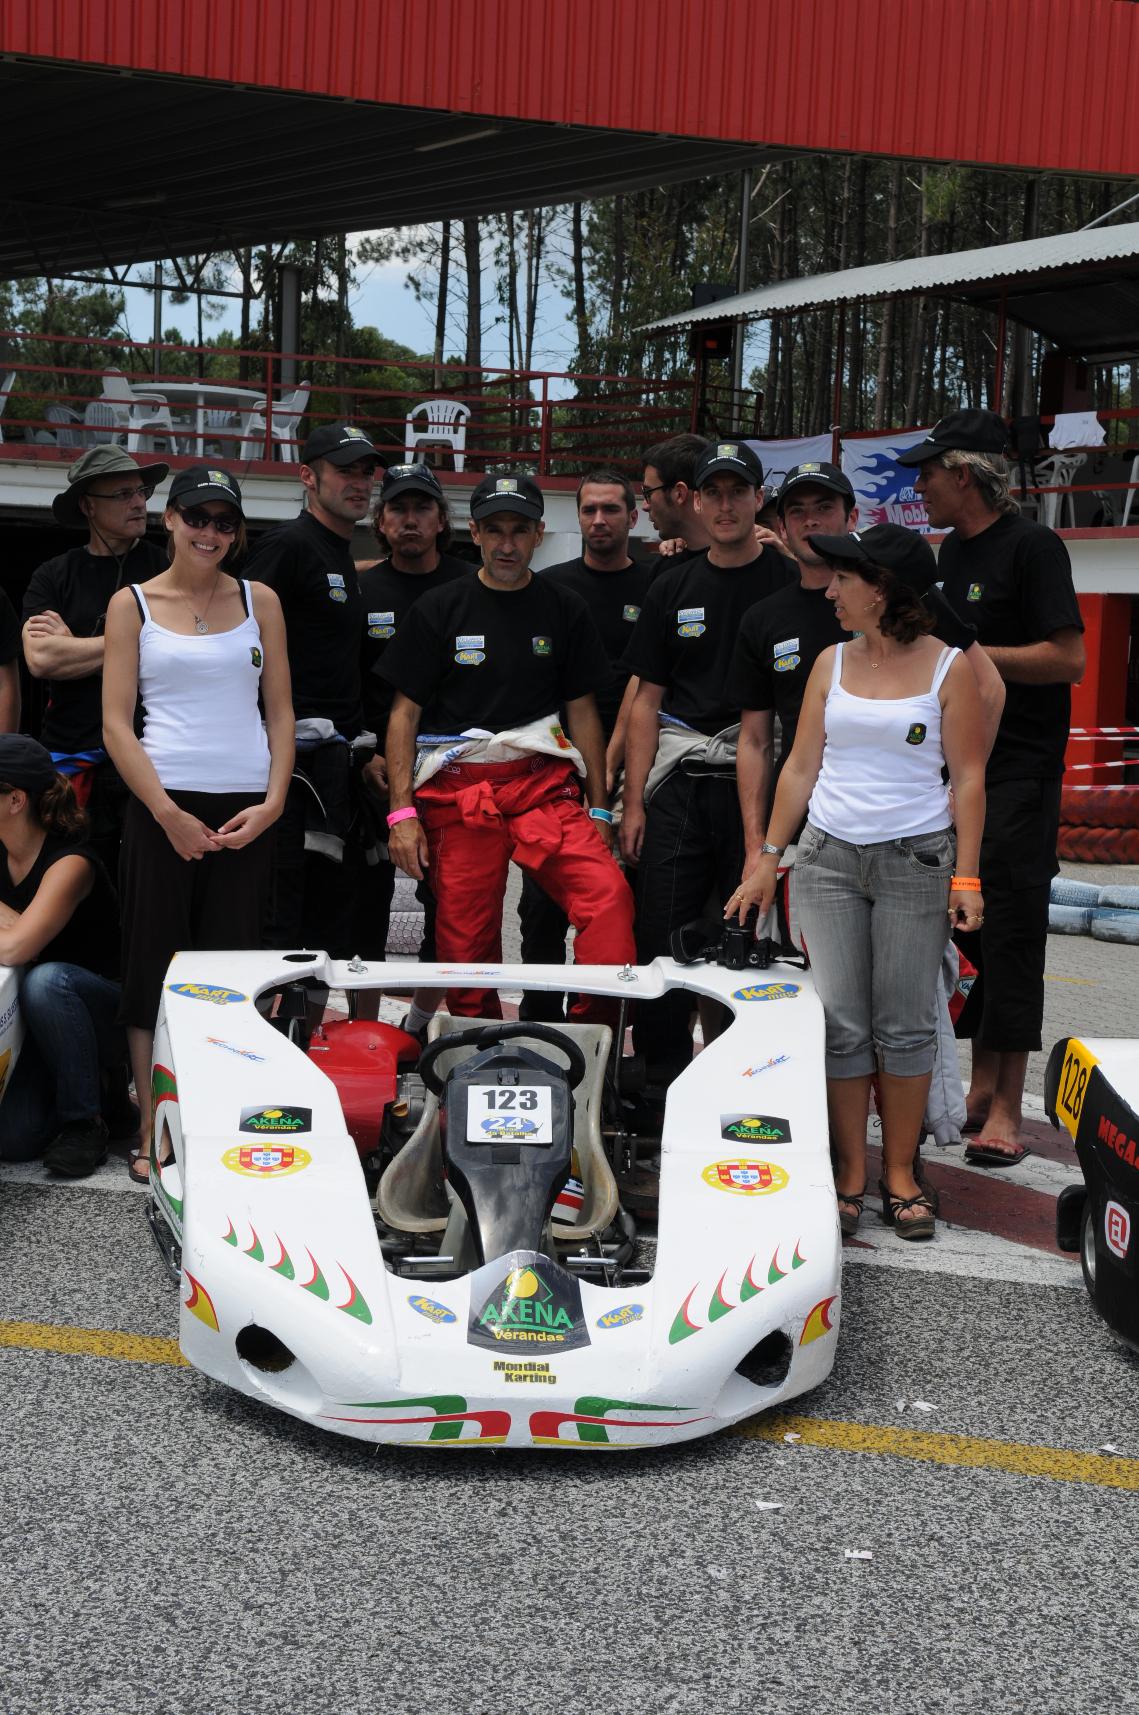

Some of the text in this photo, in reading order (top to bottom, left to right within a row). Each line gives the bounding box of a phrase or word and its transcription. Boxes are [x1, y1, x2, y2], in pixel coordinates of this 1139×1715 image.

[178, 984, 240, 999] KART
[741, 983, 787, 1000] KART
[1060, 1052, 1088, 1121] 128
[482, 1089, 538, 1111] 123
[245, 1117, 305, 1126] AKENA
[488, 1117, 524, 1130] 24
[727, 1125, 784, 1136] AKENA
[415, 1297, 451, 1317] KART
[480, 1300, 575, 1330] AKENA
[600, 1305, 635, 1327] KART
[494, 1328, 565, 1342] Vérandas
[493, 1361, 550, 1373] Mondial
[504, 1372, 557, 1384] Karting
